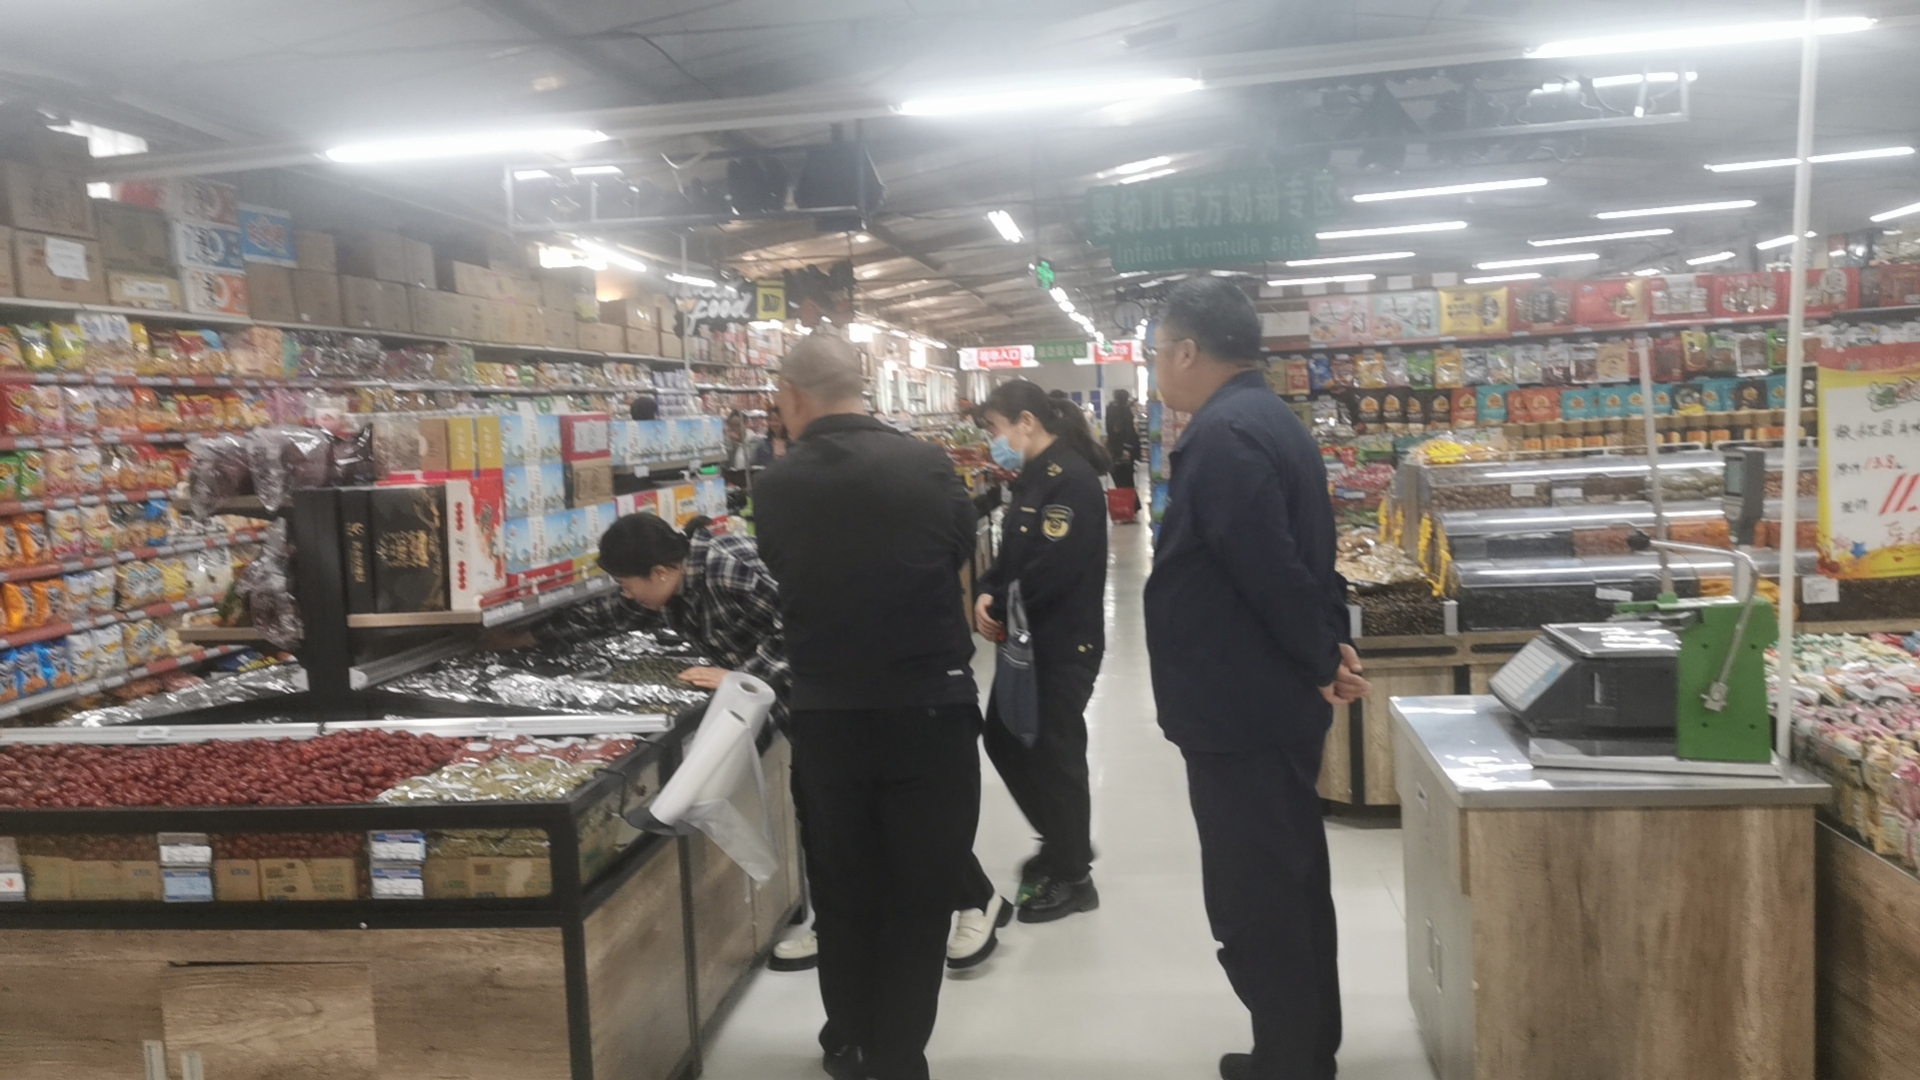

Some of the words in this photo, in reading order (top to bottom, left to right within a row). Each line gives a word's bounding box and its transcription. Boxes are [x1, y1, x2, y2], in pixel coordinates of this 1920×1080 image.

[1092, 171, 1336, 235] 婴幼儿配方奶粉专区
[1116, 240, 1174, 266] Infant
[1183, 234, 1262, 260] formula
